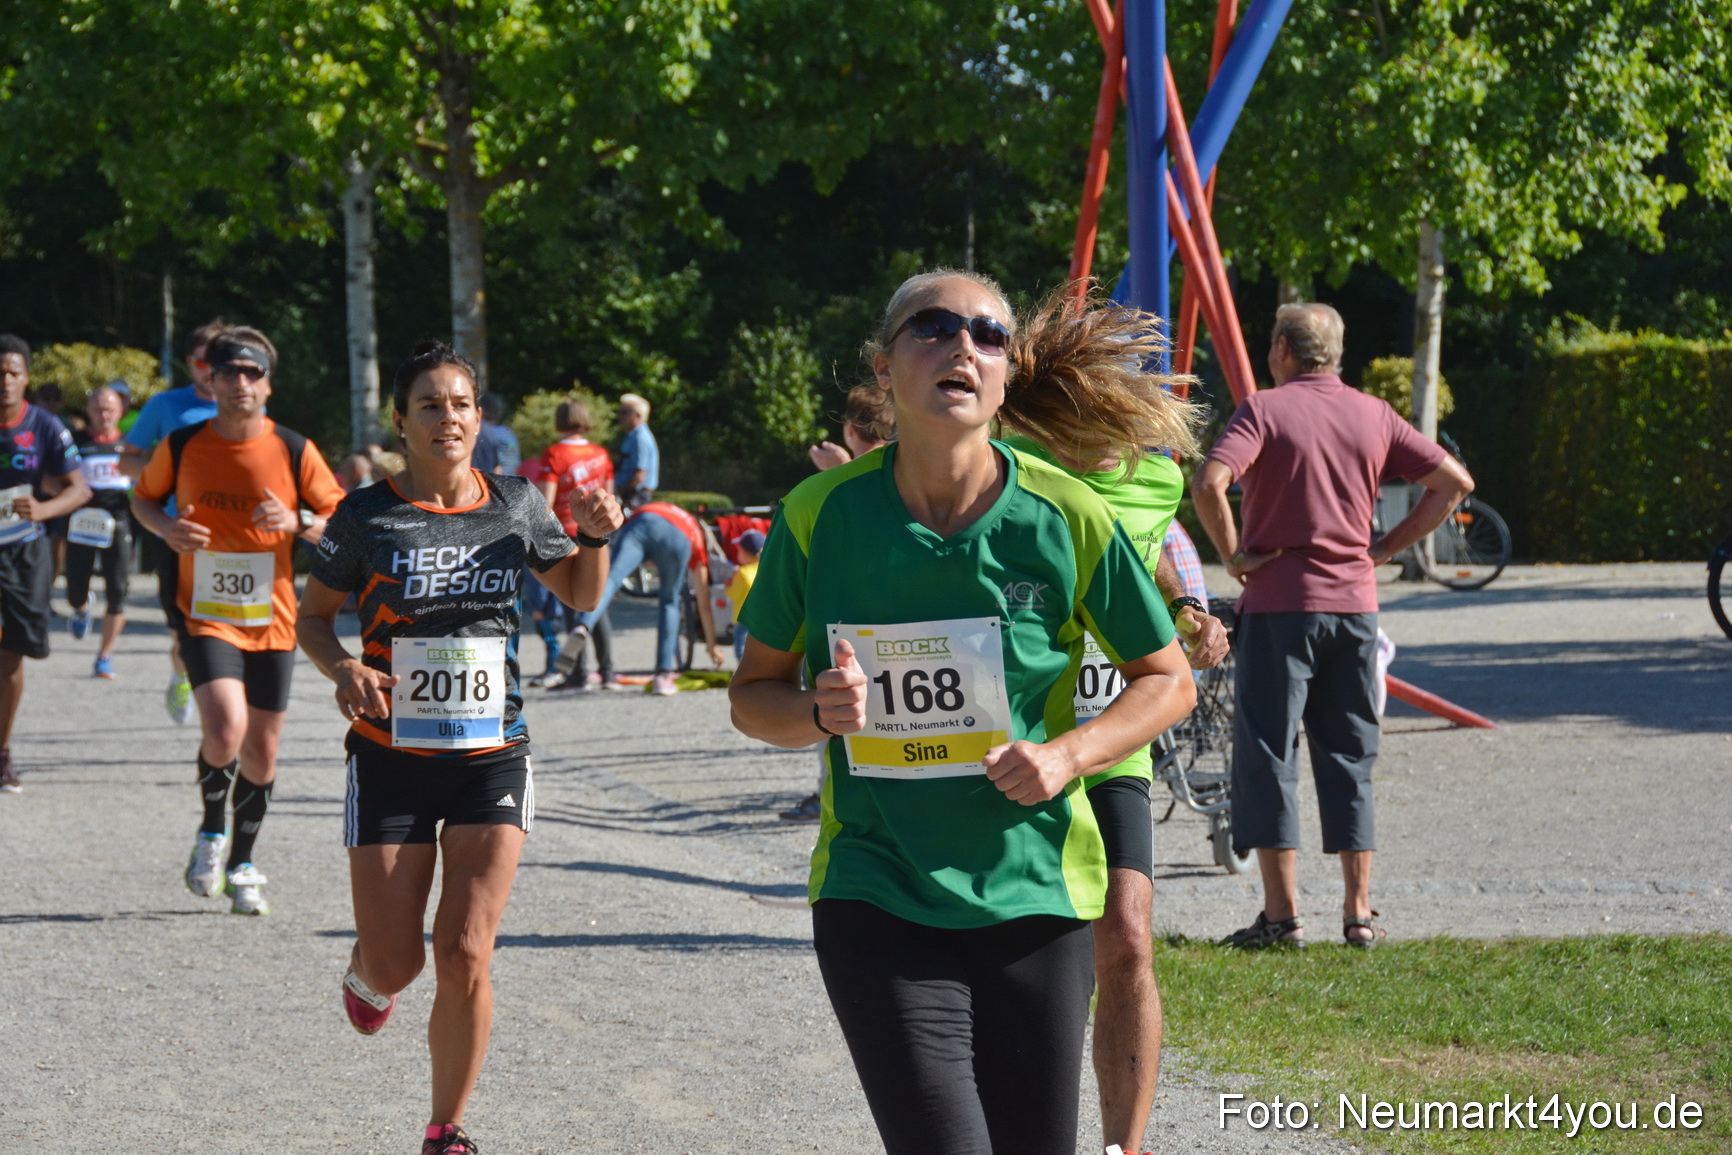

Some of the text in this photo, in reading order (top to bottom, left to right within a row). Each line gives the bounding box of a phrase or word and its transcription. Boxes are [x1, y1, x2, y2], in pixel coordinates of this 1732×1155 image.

[392, 545, 482, 573] HECK
[212, 572, 255, 595] 330
[404, 568, 522, 600] DESIGN
[997, 581, 1049, 603] AOK
[427, 649, 477, 660] BOCK
[876, 637, 950, 656] BOCK
[410, 669, 490, 702] 2018
[873, 667, 965, 715] 168
[417, 707, 442, 715] PARTL
[438, 722, 464, 736] Ulla
[875, 719, 960, 732] PARTL Neumarkt
[903, 742, 949, 762] Sina
